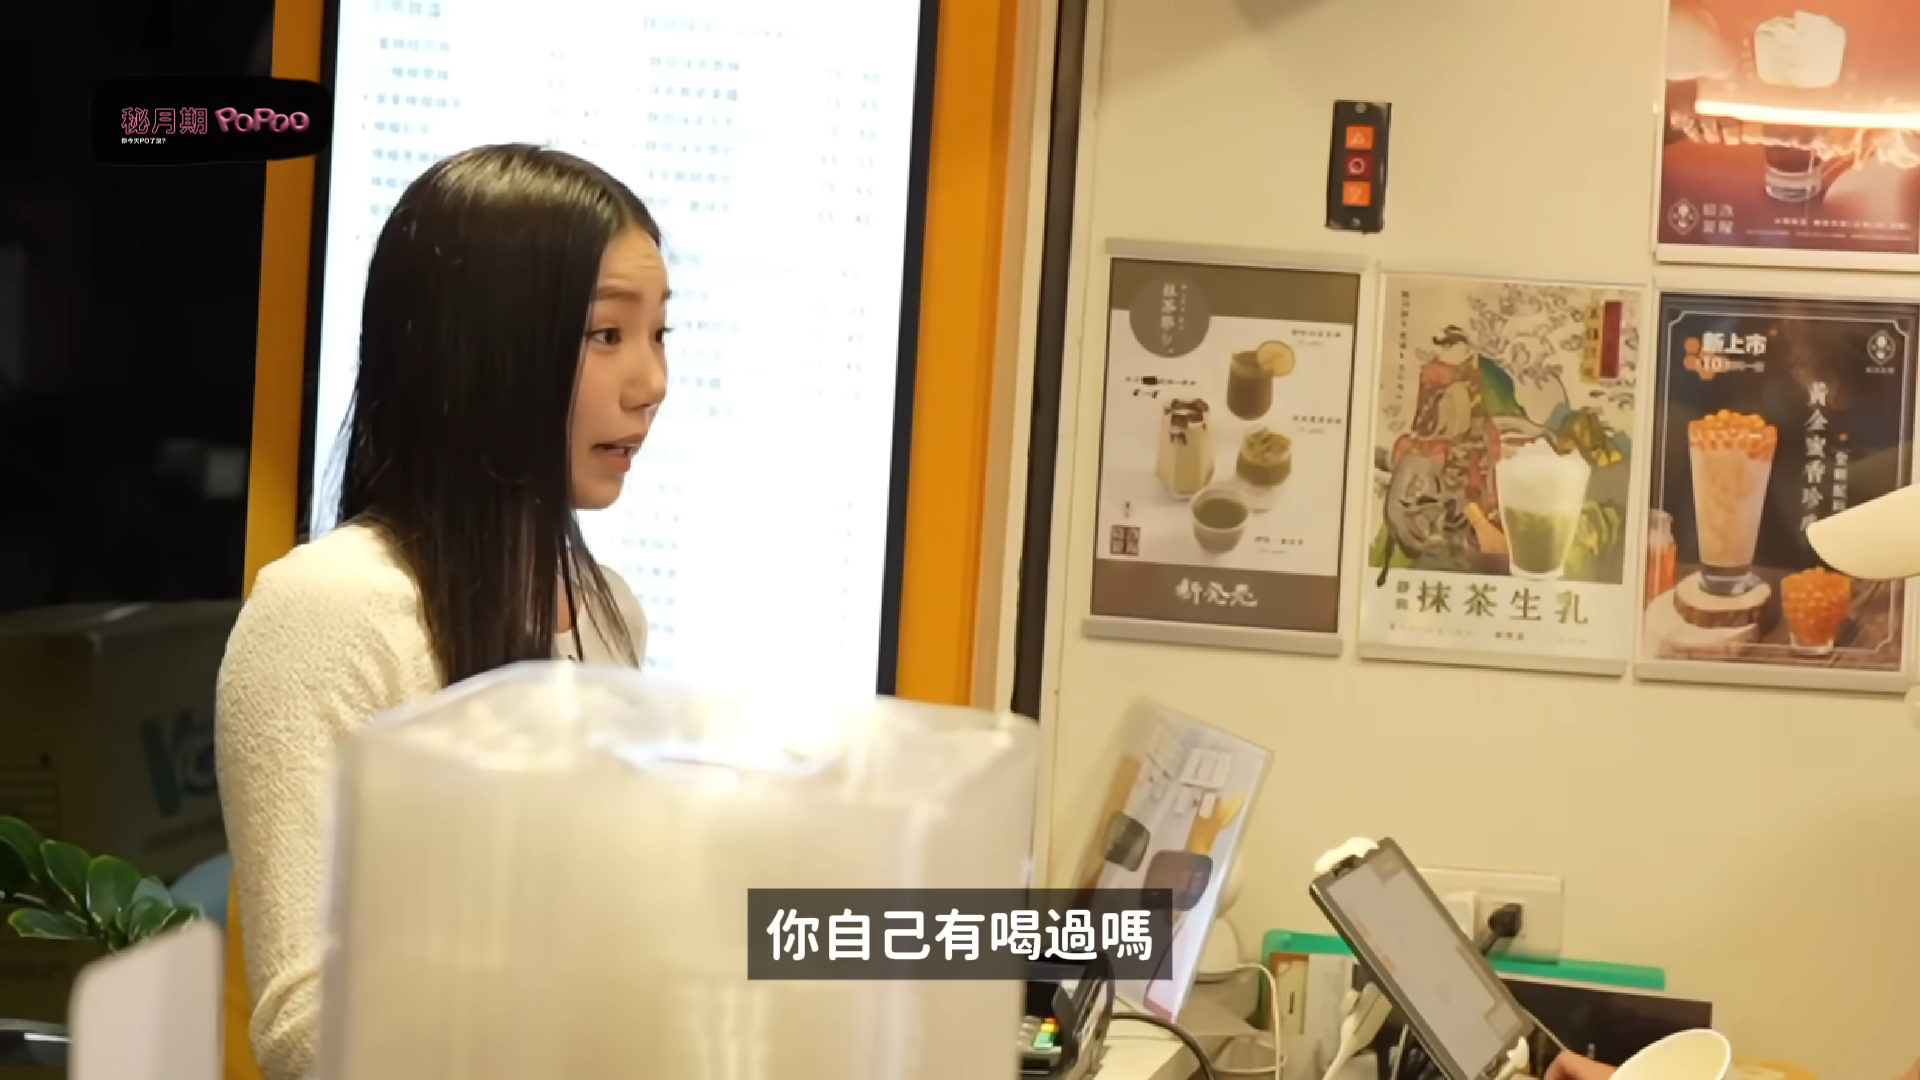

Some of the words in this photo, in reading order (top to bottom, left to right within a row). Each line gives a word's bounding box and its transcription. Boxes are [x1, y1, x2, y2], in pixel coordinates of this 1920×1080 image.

[1702, 331, 1767, 355] 新上市
[1416, 580, 1588, 625] 抹茶生乳
